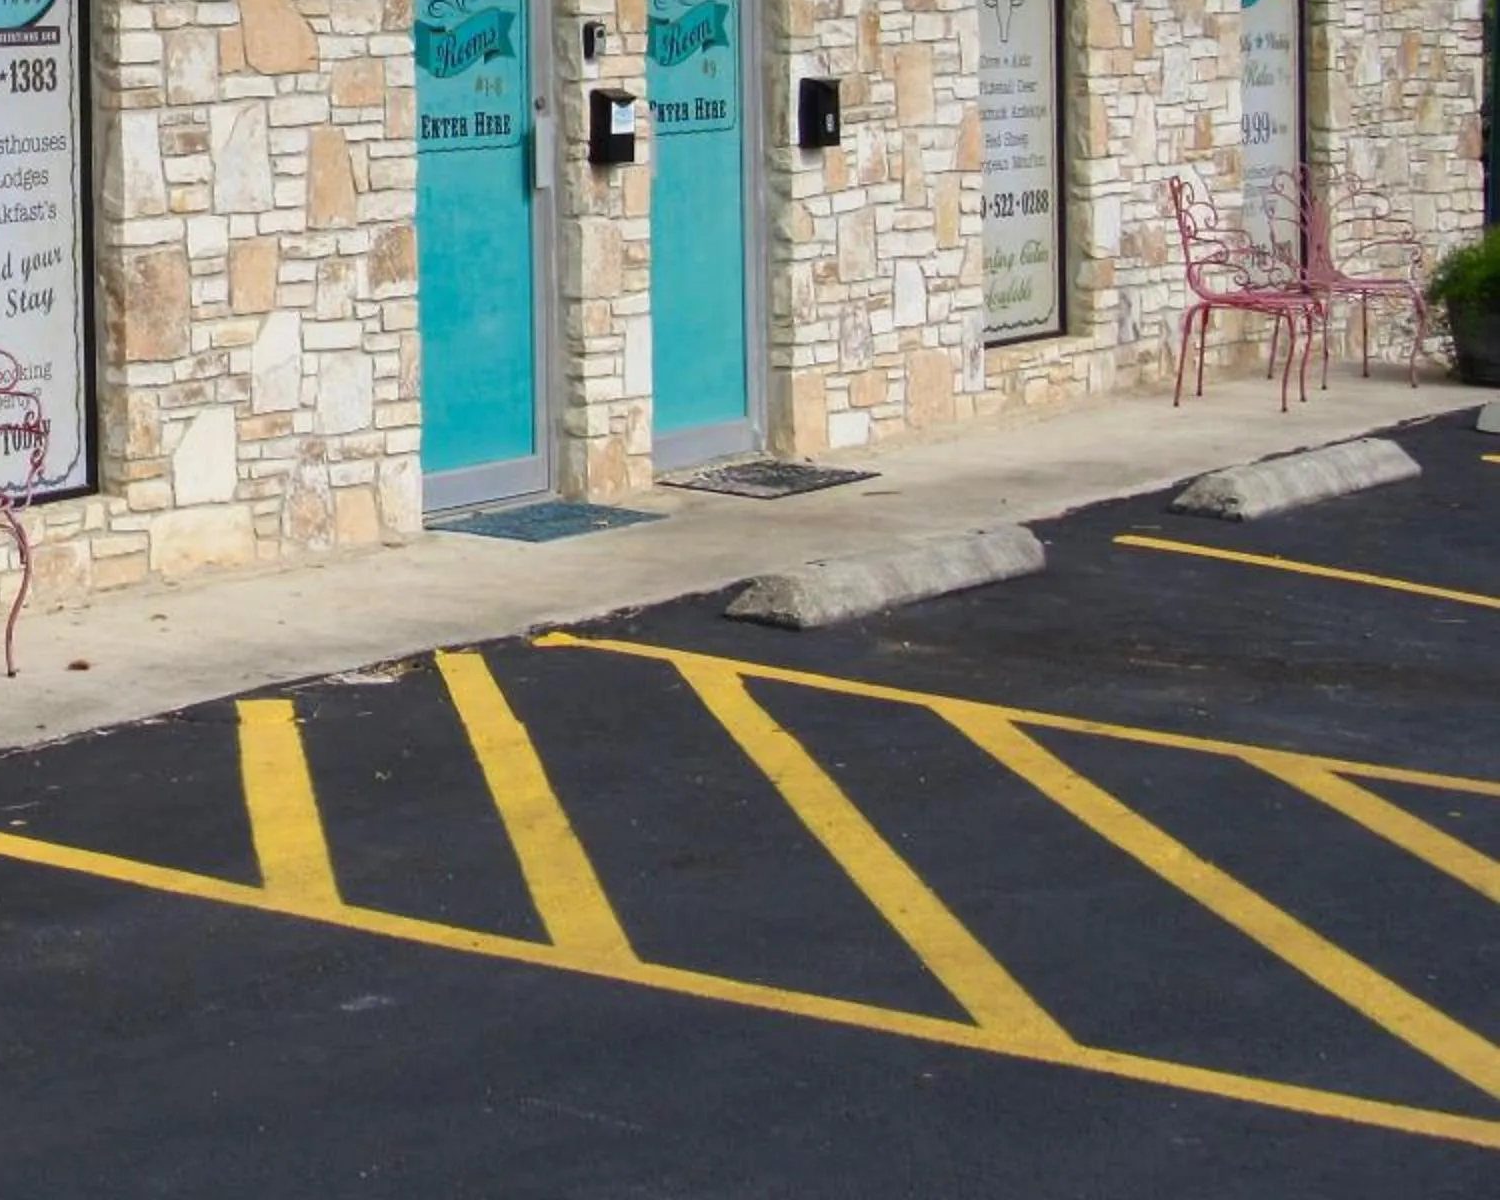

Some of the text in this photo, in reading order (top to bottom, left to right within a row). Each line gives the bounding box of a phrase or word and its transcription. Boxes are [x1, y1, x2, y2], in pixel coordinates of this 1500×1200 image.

[694, 97, 727, 120] HERE
[421, 111, 511, 139] ENTER HERE
[21, 247, 64, 281] your
[6, 287, 55, 318] Stay
